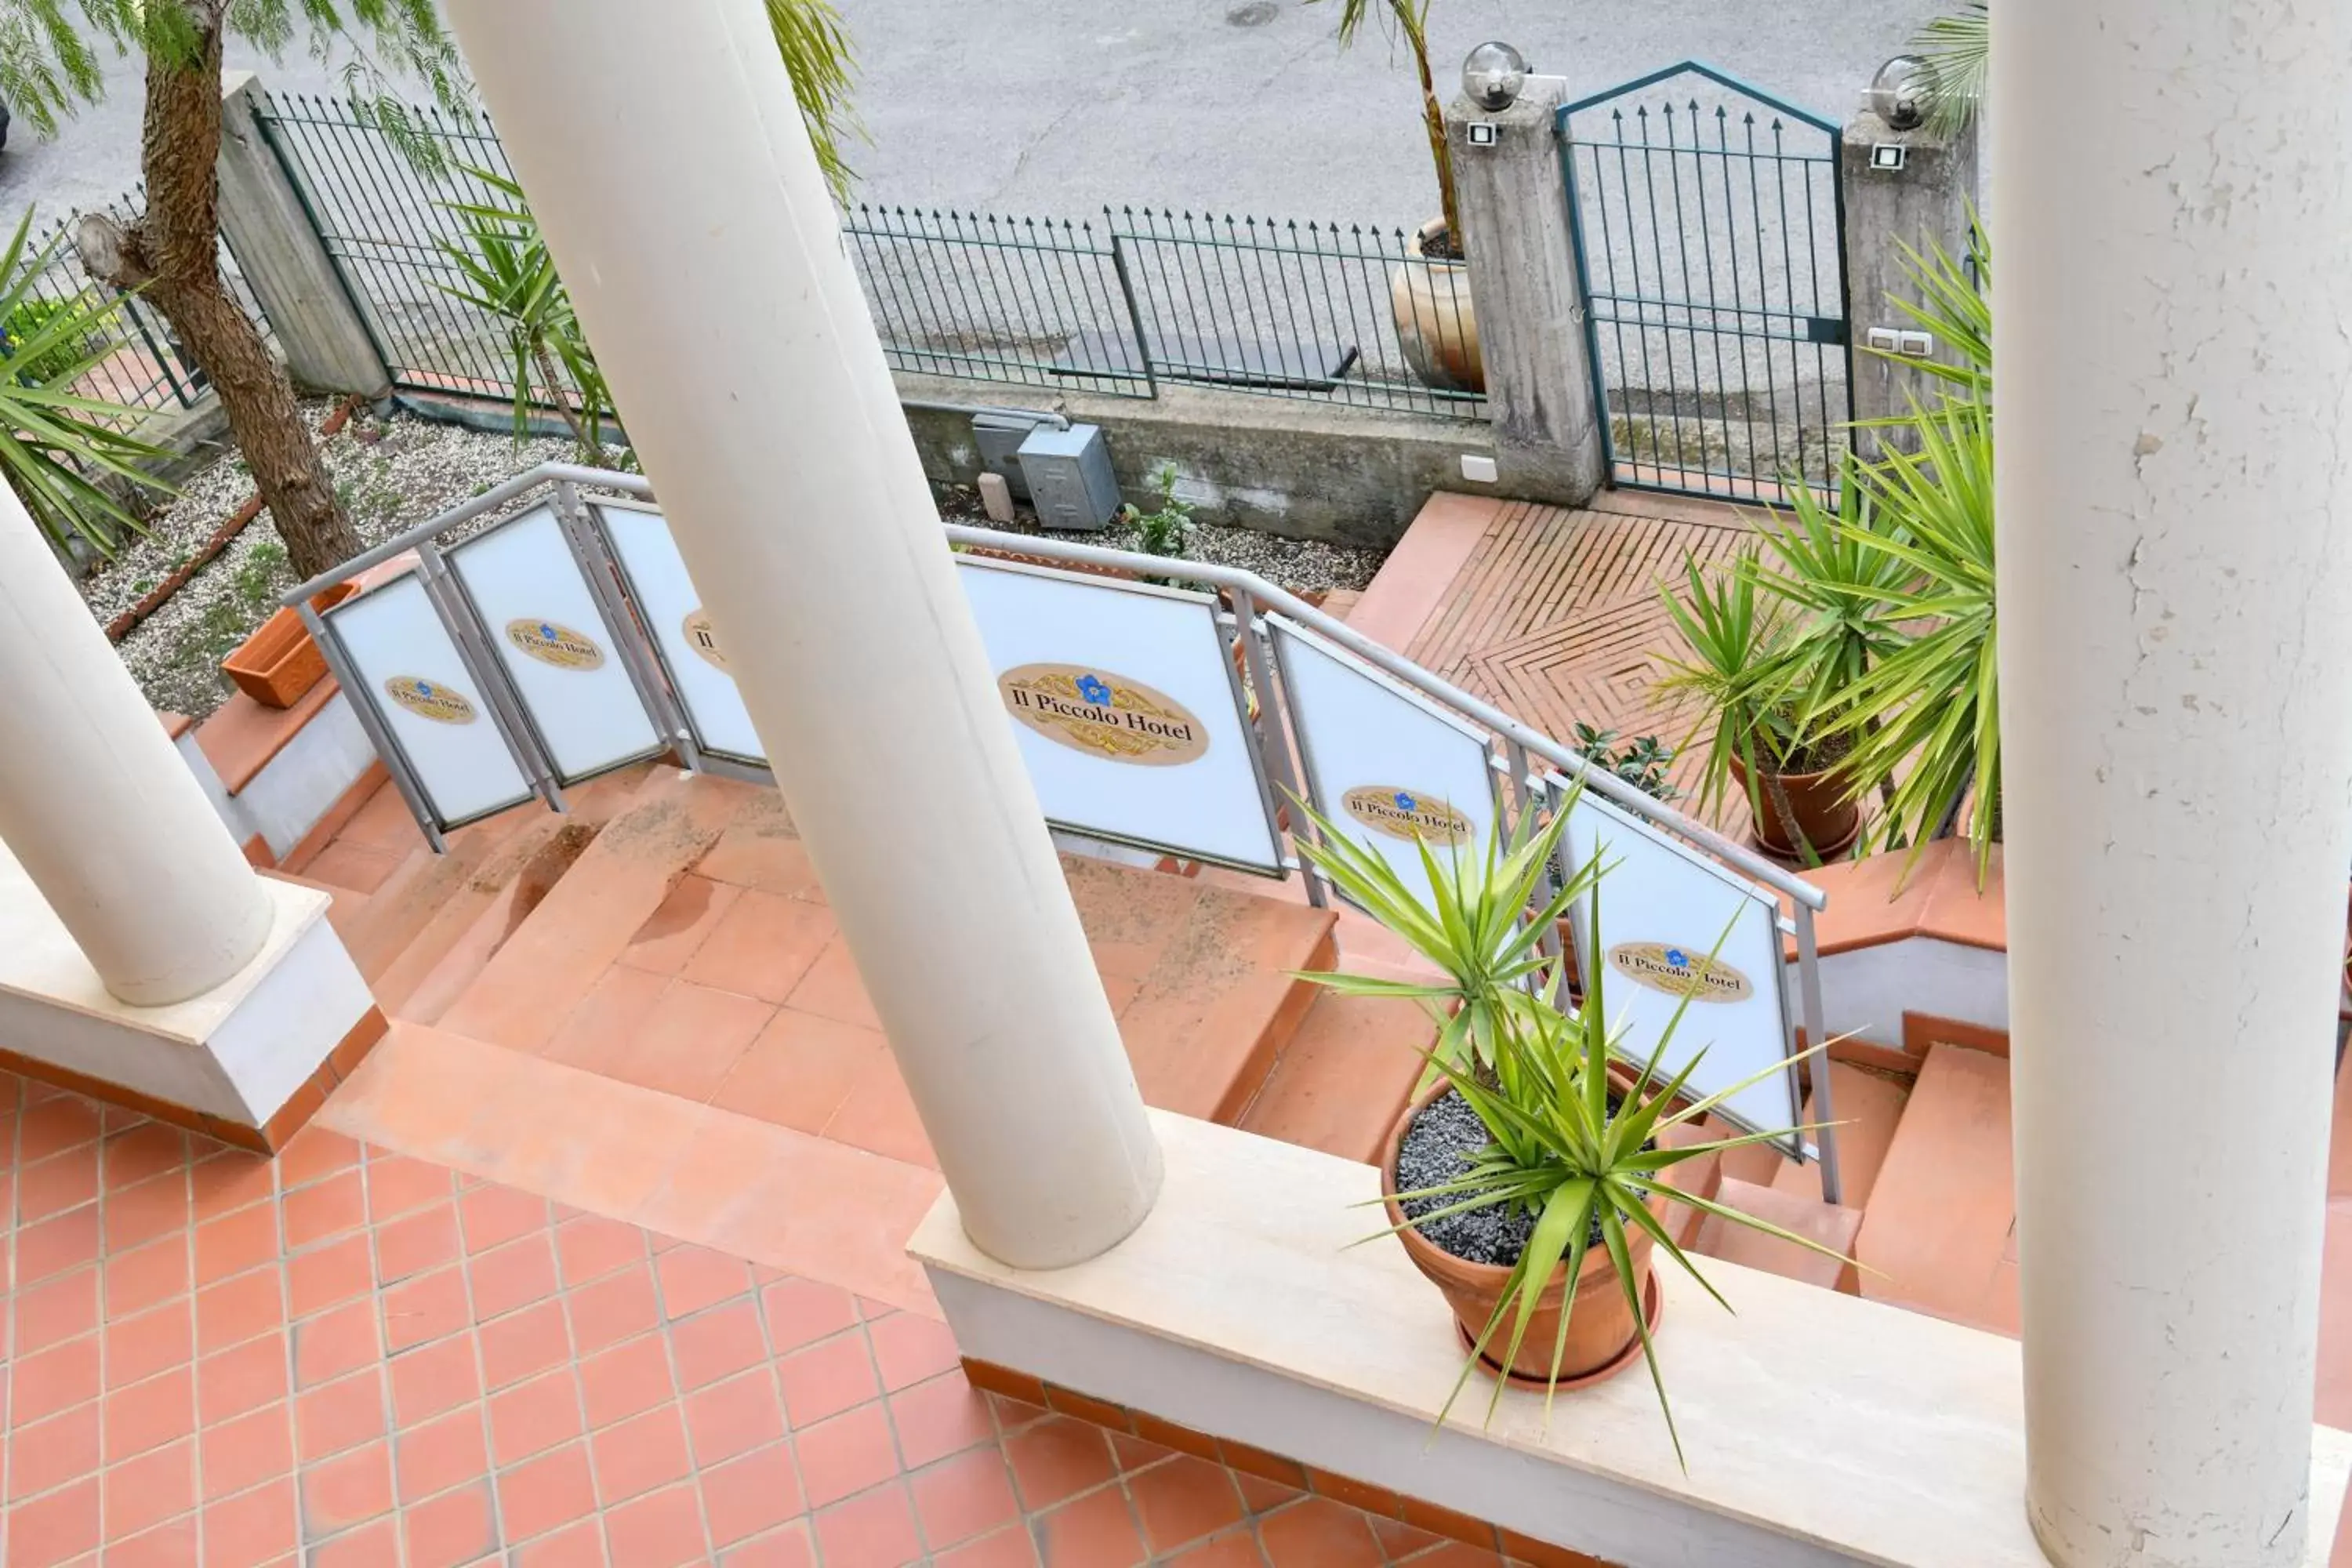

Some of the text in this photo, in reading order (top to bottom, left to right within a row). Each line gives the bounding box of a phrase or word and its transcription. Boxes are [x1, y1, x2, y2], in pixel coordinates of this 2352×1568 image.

[565, 643, 597, 657] Hotel
[1012, 689, 1192, 741] Il Piccolo Hotel
[1352, 800, 1362, 811] Il
[1367, 803, 1420, 822] Piccolo
[1618, 954, 1628, 964] Il
[1635, 957, 1691, 979] Piccolo
